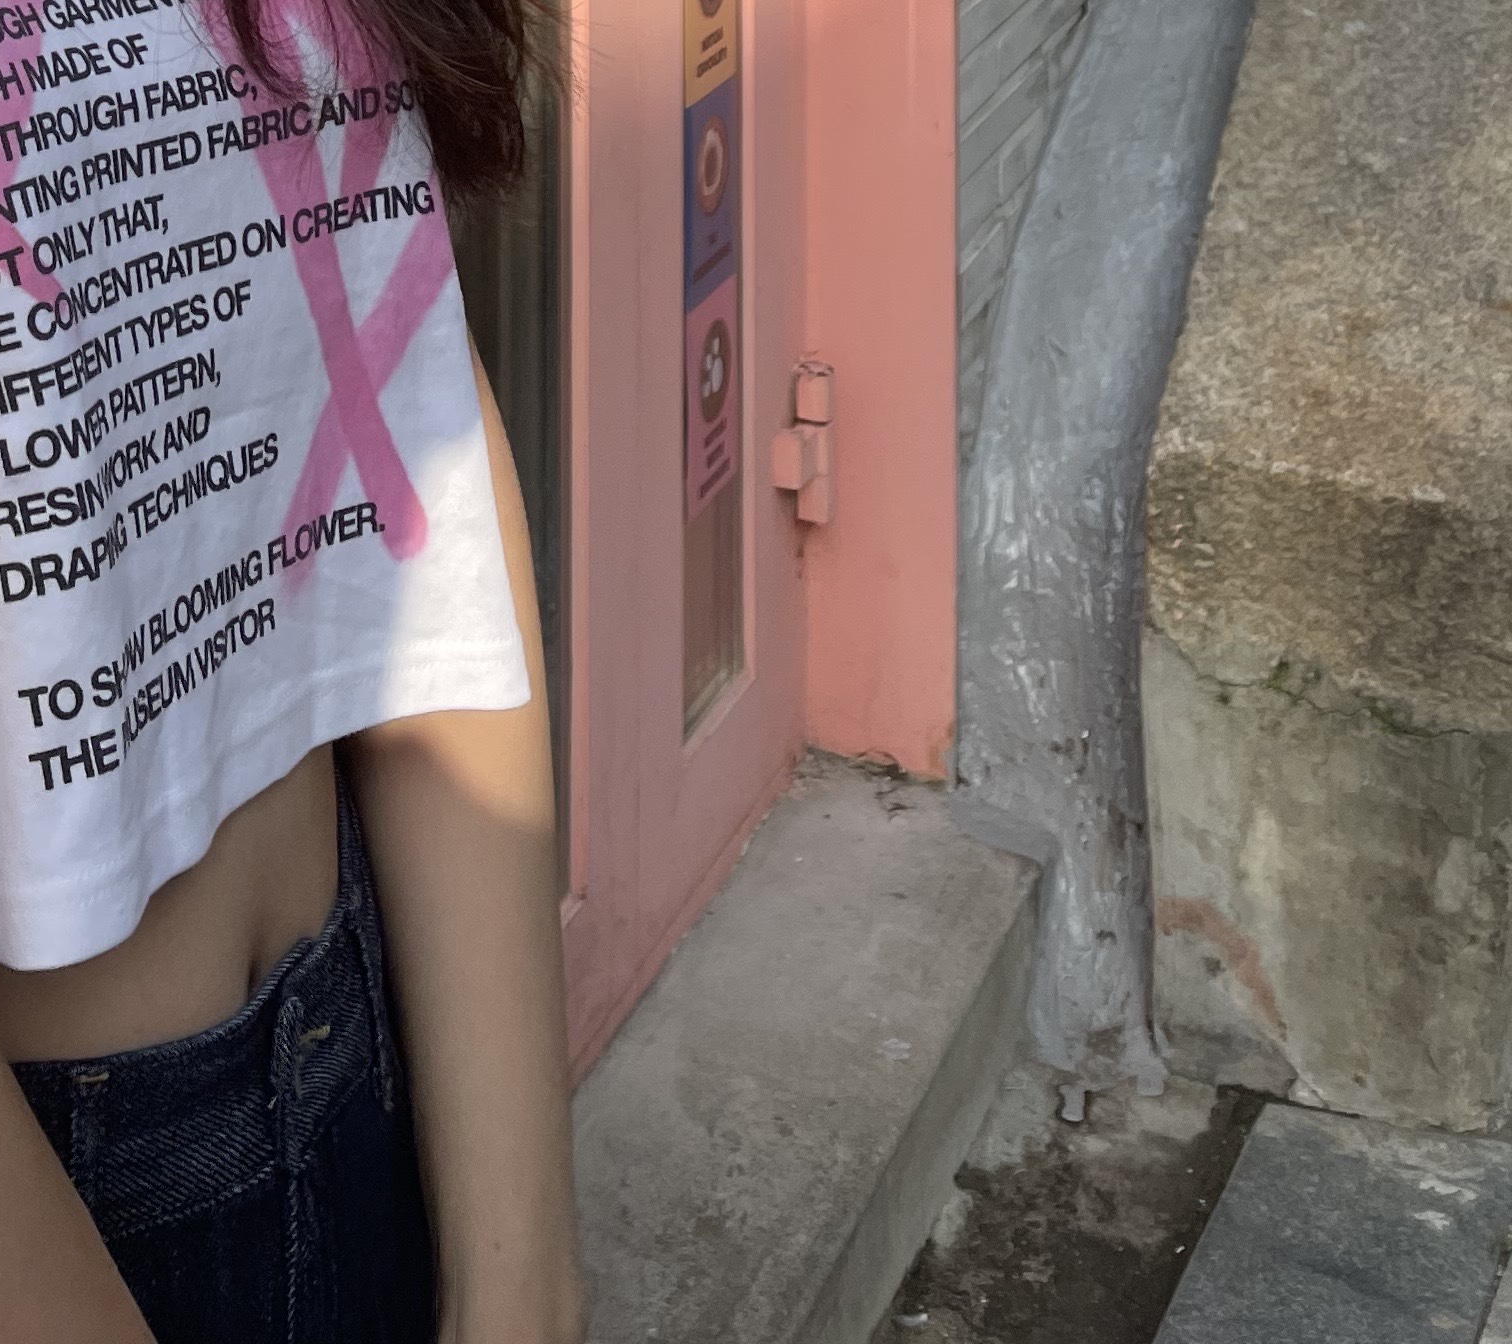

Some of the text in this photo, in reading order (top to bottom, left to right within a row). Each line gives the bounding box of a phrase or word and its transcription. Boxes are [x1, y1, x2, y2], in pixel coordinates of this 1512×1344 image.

[21, 43, 112, 93] MADE
[107, 33, 149, 69] OF
[143, 64, 258, 120] FABRIC,
[81, 130, 202, 196] PRINTED
[206, 101, 313, 160] FABRIC
[317, 86, 381, 132] AND
[27, 231, 237, 341] CONCENTRATED
[242, 214, 287, 257] ON
[292, 180, 436, 244] CREATING
[32, 216, 96, 275] ONLY
[99, 194, 169, 247] THAT,
[125, 294, 210, 355] TYPES
[213, 279, 251, 322] OF
[108, 348, 221, 429] PATTERN,
[163, 406, 211, 460] AND
[128, 432, 279, 539] TECHNIQUES
[18, 678, 84, 728] TO
[149, 550, 262, 656] BLOOMING
[267, 502, 385, 576] FLOWER.
[28, 729, 120, 791] THE
